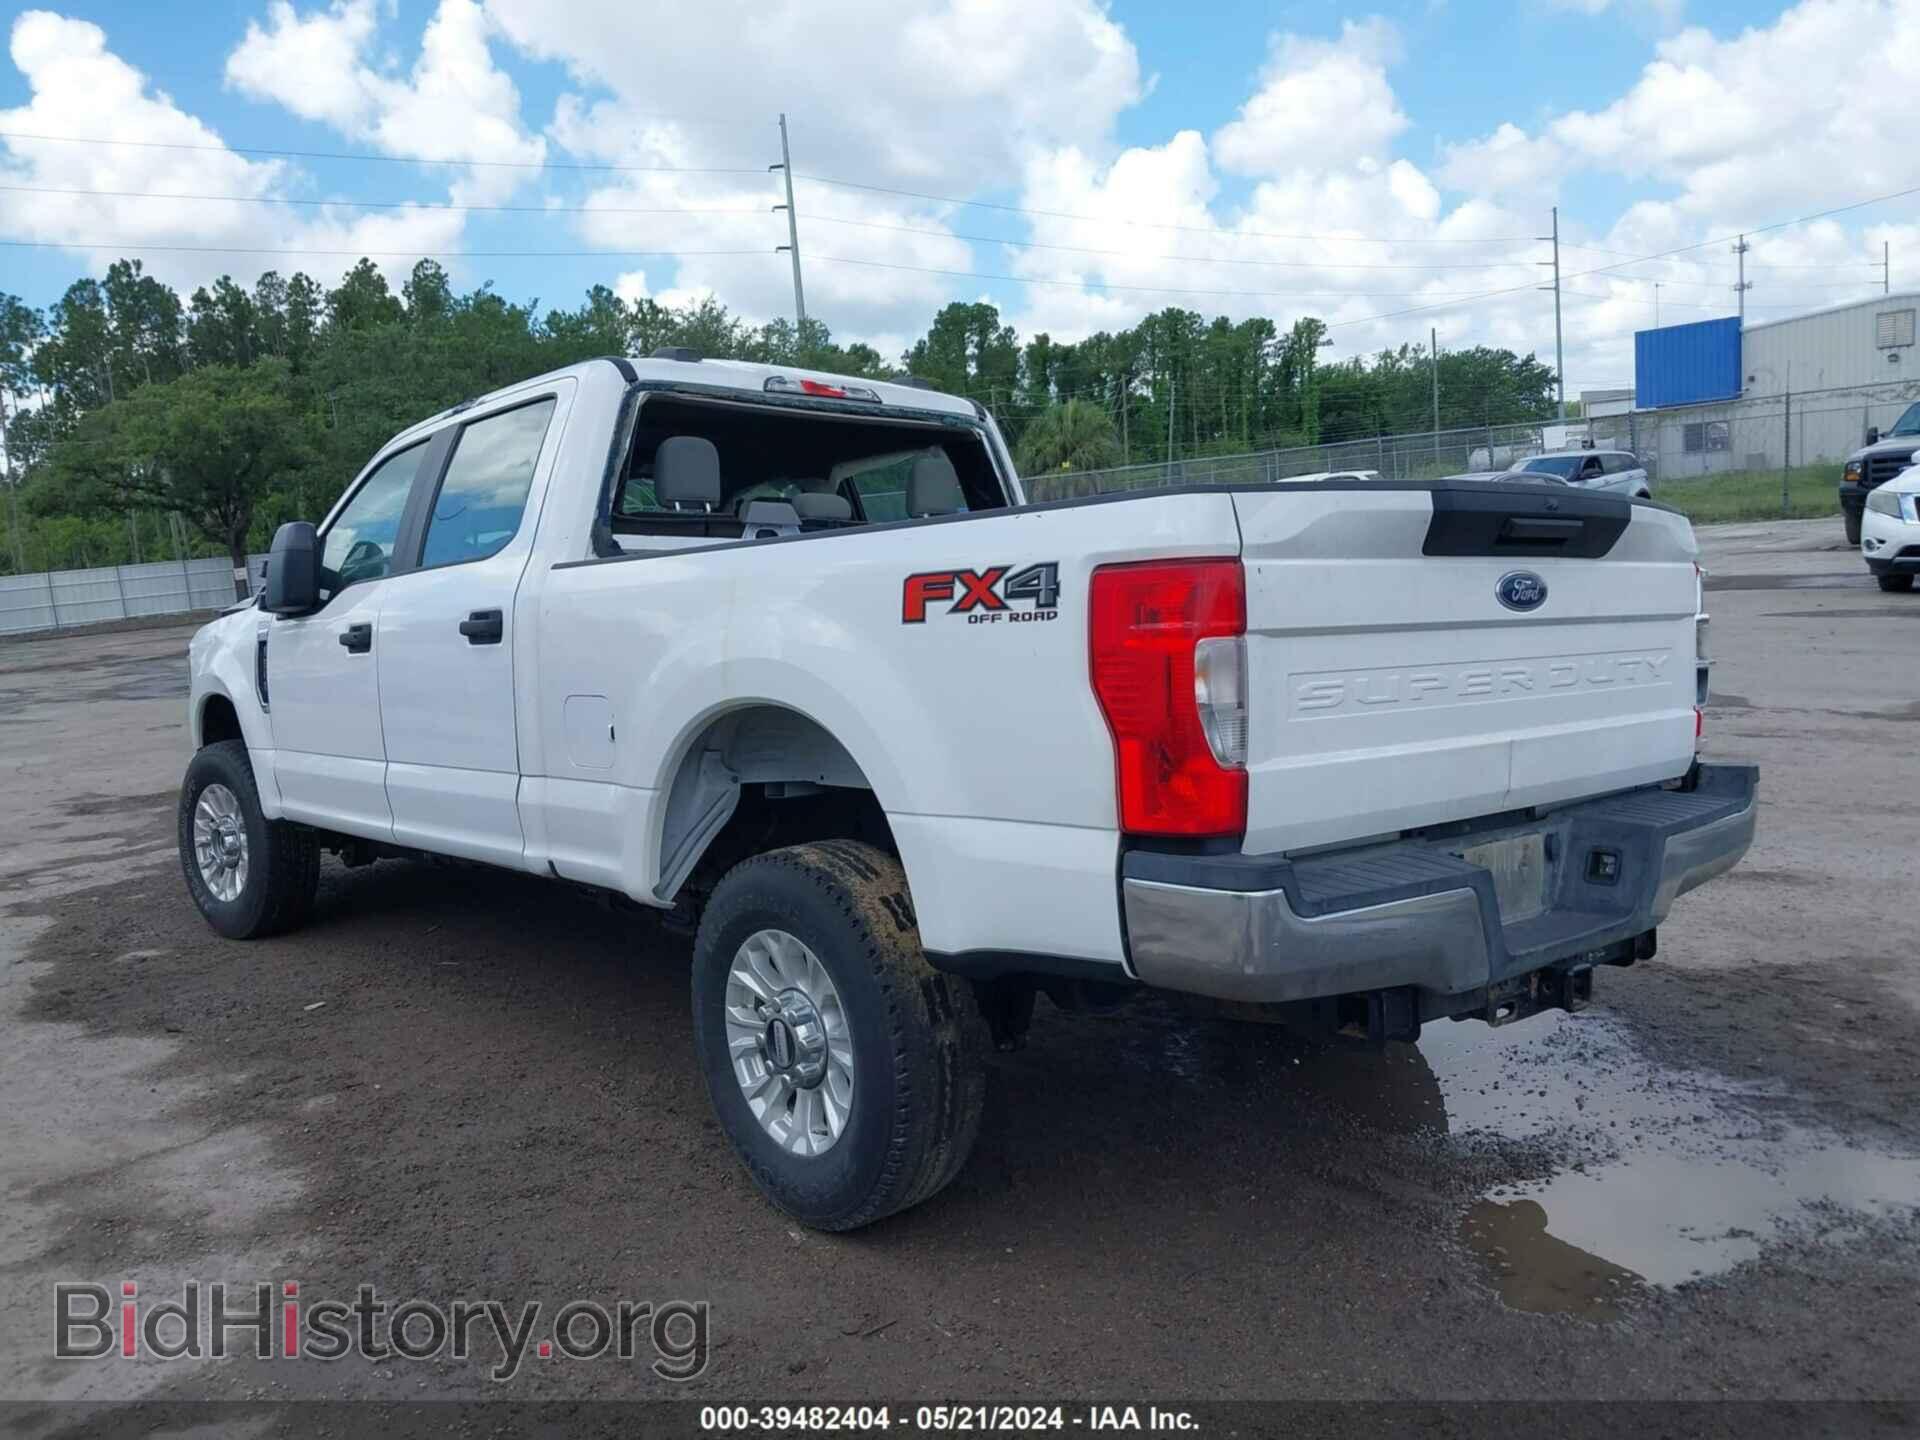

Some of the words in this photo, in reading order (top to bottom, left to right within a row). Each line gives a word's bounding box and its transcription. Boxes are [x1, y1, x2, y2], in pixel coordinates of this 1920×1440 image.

[902, 561, 1060, 624] FX4
[1512, 579, 1540, 601] Ford
[968, 613, 1002, 625] OFF
[1009, 611, 1058, 623] ROAD
[1297, 666, 1534, 712] SUPER
[1549, 655, 1669, 689] DUTY
